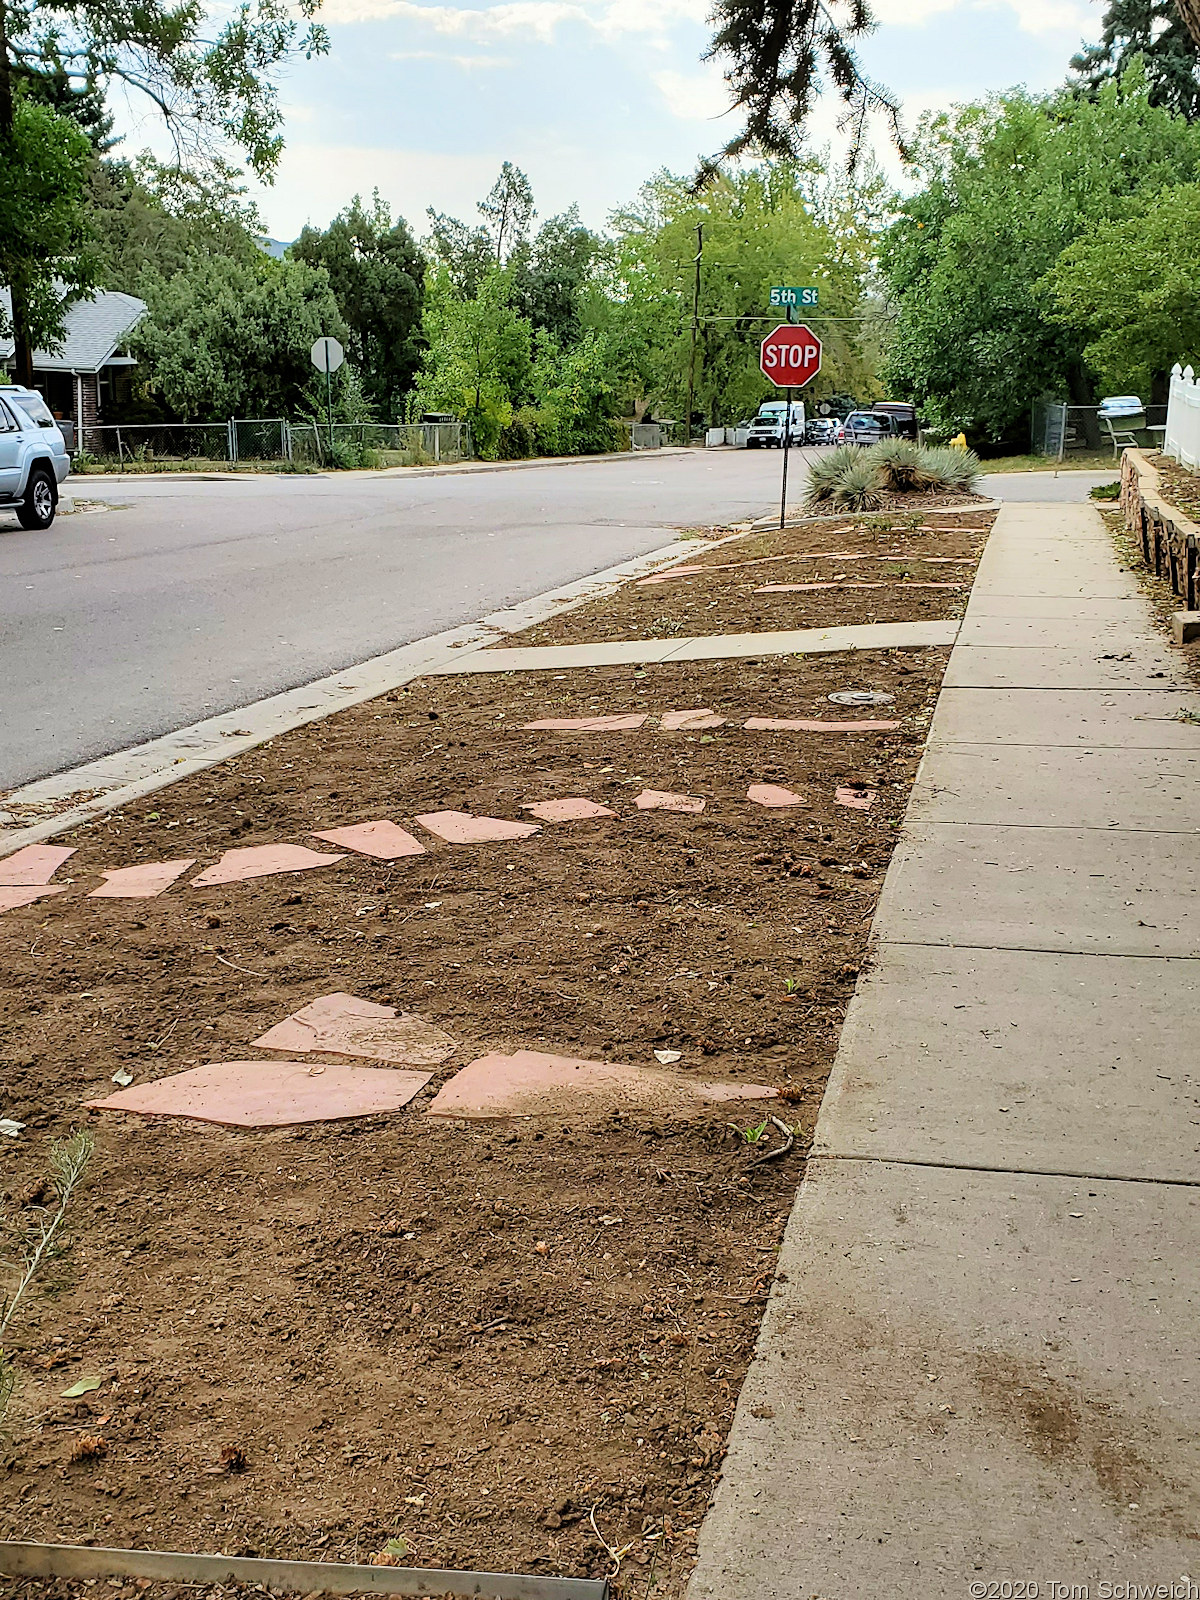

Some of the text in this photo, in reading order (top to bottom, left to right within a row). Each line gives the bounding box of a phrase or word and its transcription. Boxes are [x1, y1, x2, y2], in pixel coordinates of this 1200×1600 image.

[770, 289, 819, 304] 5th St
[764, 344, 818, 368] STOP
